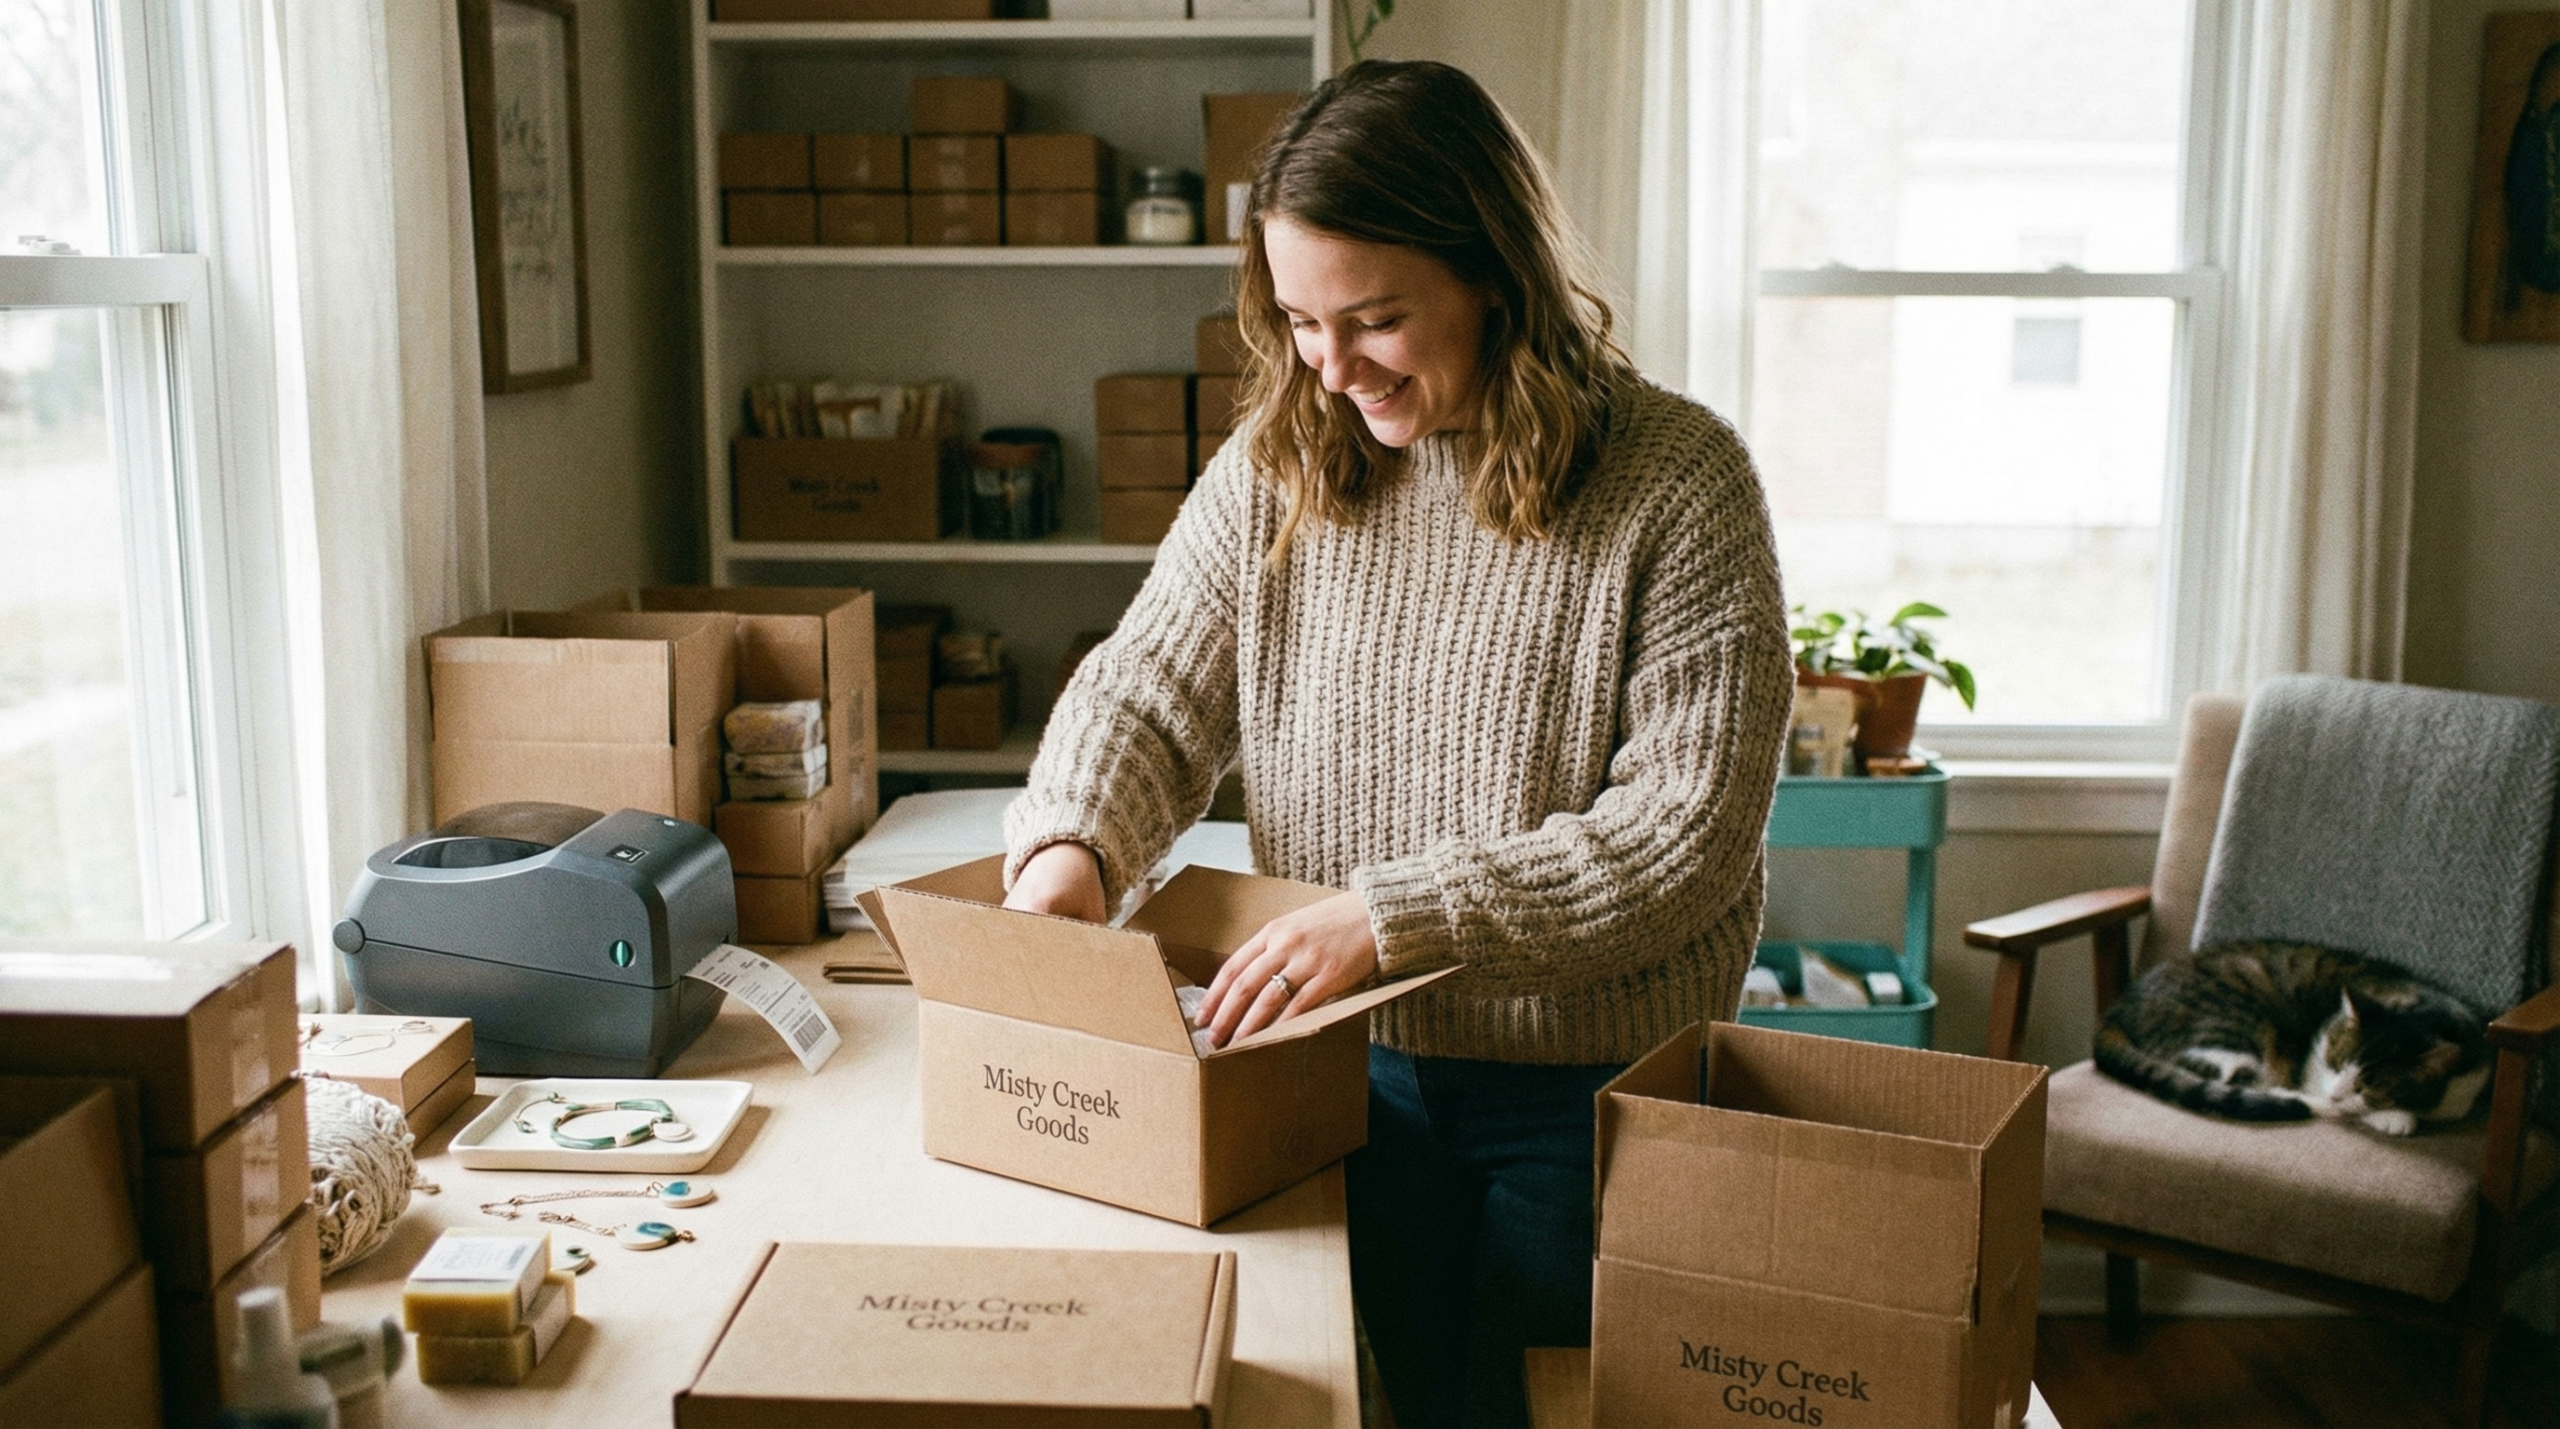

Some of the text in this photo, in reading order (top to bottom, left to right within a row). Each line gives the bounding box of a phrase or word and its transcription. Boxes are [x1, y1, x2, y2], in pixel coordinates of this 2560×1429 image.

[982, 1063, 1121, 1119] Misty Creek
[1016, 1105, 1089, 1145] Goods
[858, 1294, 1088, 1316] Misty Creek
[905, 1314, 1030, 1333] Goods
[1679, 1340, 1870, 1402] Misty Creek
[1722, 1384, 1823, 1427] Goods
